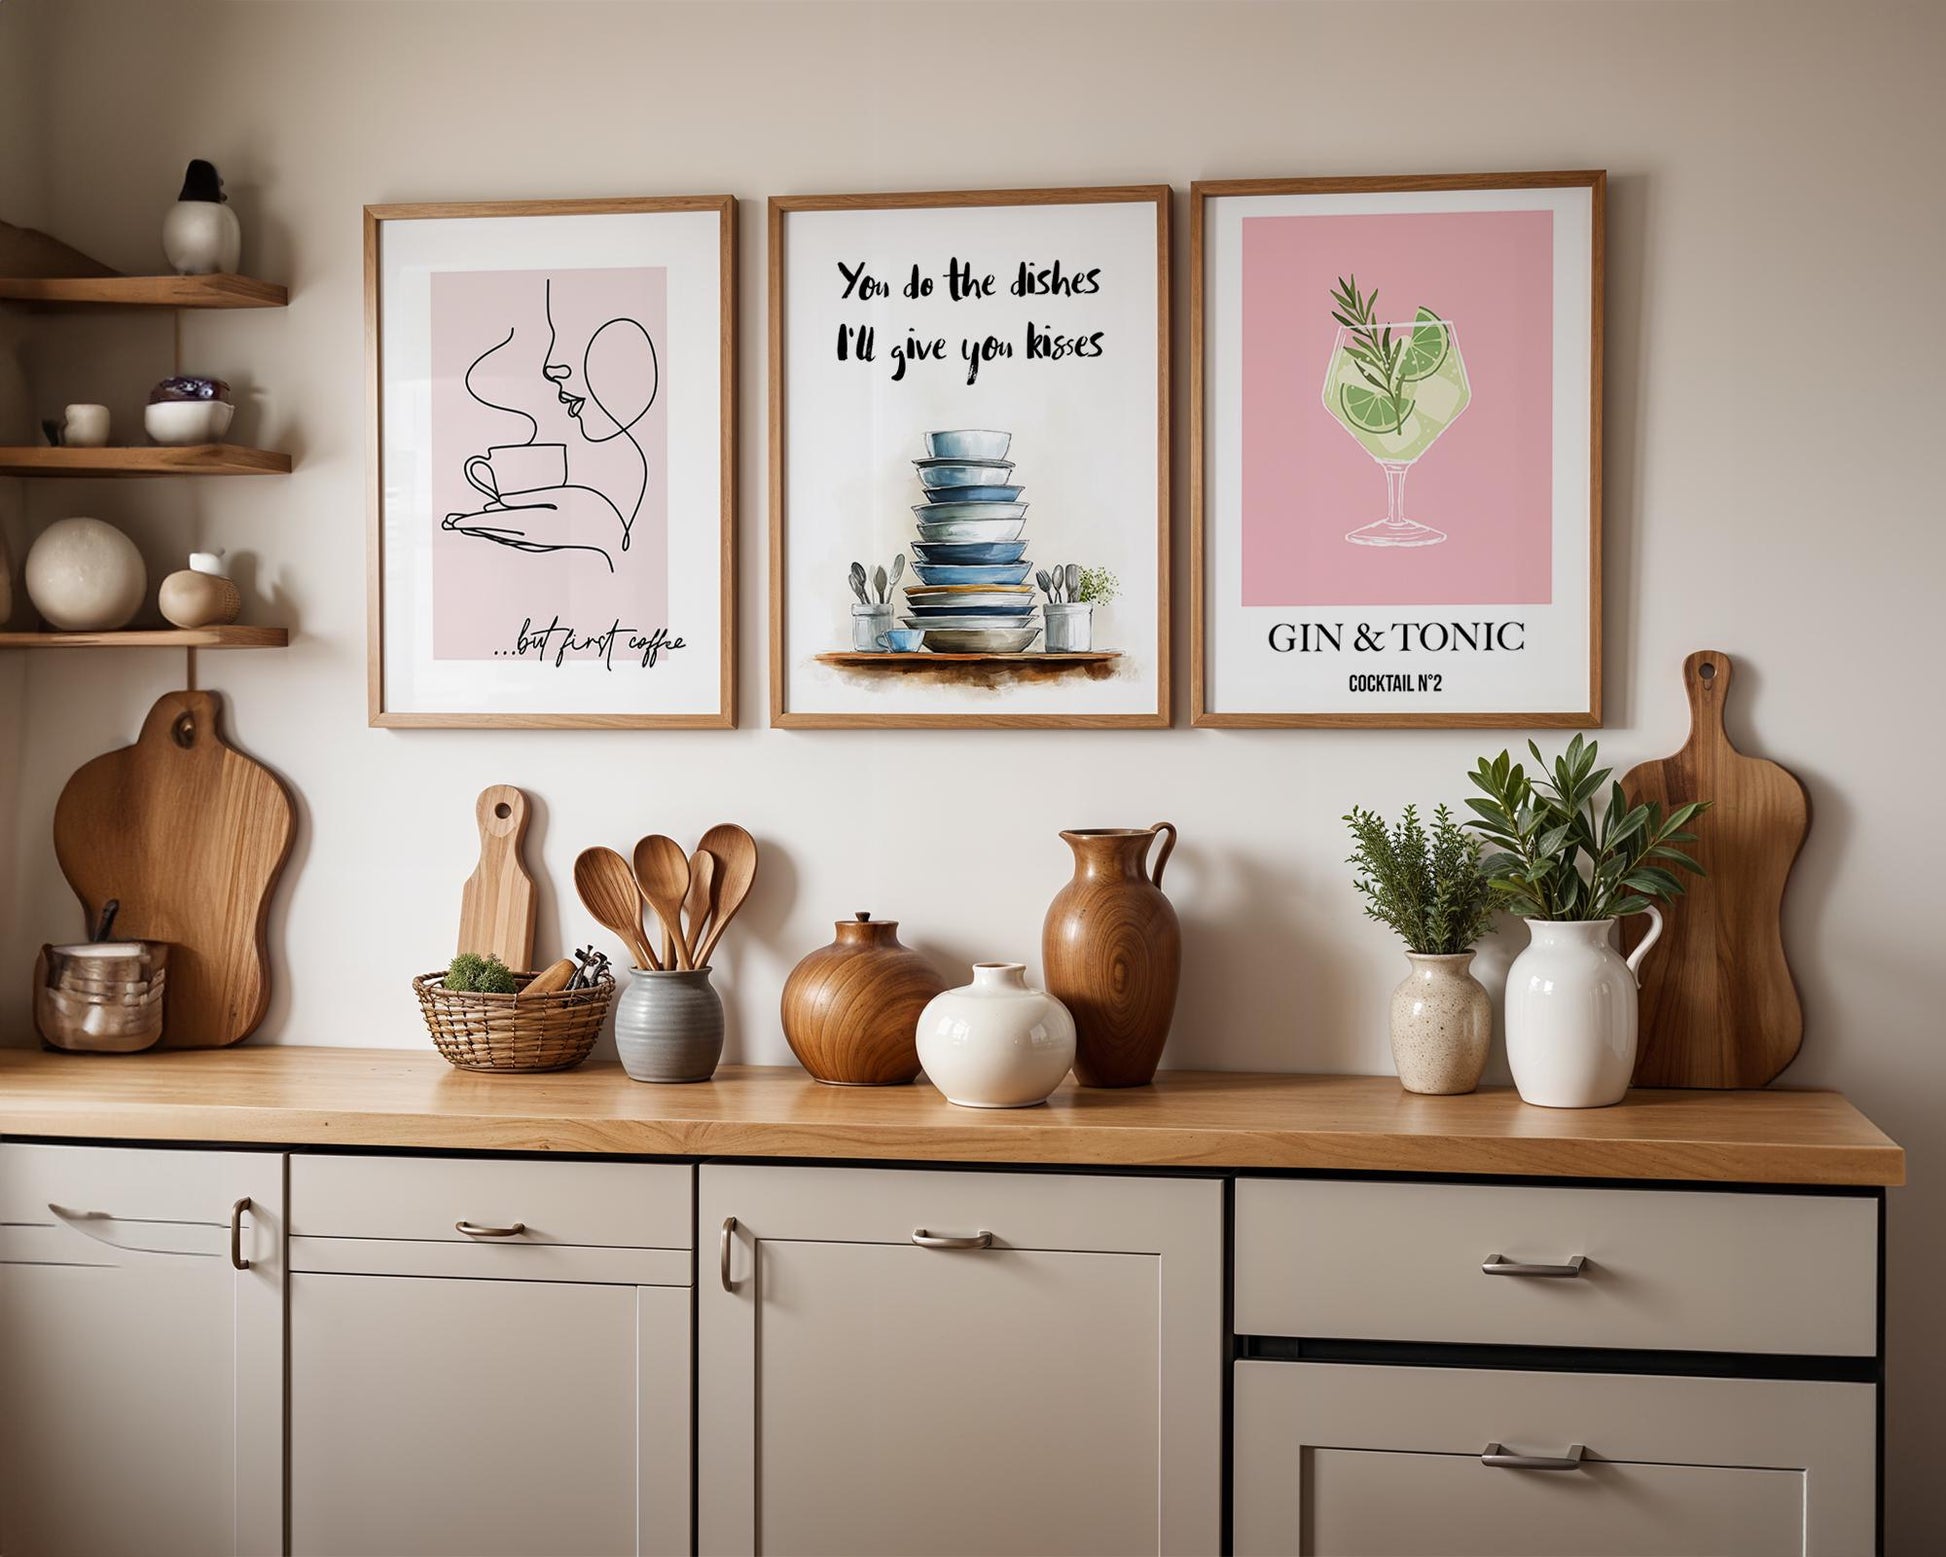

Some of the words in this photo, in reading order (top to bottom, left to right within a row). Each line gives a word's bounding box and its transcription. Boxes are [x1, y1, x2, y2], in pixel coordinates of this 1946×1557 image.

[837, 261, 890, 301] You
[903, 263, 934, 300] do
[942, 256, 996, 302] the
[1010, 259, 1101, 298] dishes
[837, 323, 876, 362] I'll
[890, 327, 947, 382] give
[961, 335, 1013, 386] you
[1026, 321, 1105, 361] kisses
[555, 618, 638, 672] first
[628, 628, 687, 668] coffee
[1268, 623, 1344, 653] GIN
[1353, 622, 1386, 652] &
[1390, 621, 1526, 652] TONIC
[1349, 674, 1415, 693] COCKTAIL
[1418, 673, 1443, 692] N°2
